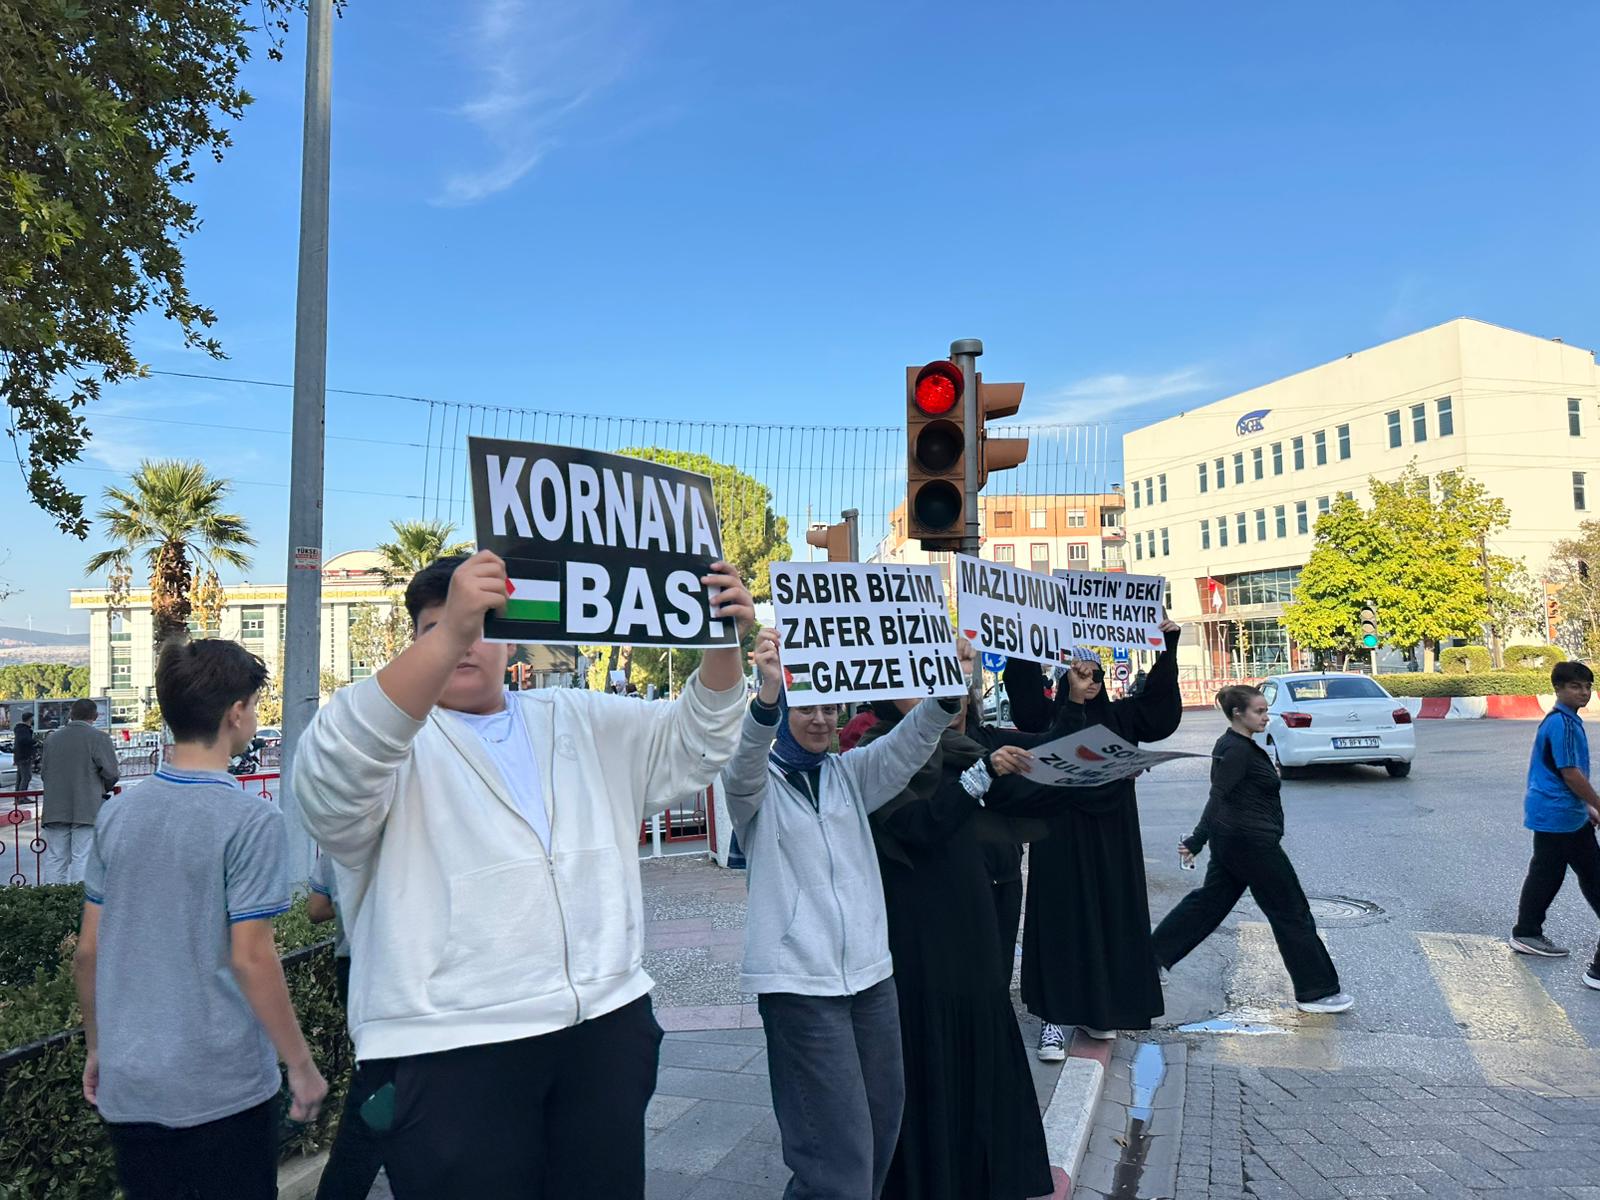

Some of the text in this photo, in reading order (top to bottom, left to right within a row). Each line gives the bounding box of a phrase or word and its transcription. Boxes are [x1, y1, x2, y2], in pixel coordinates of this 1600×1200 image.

[486, 454, 719, 558] KORNAYA
[565, 560, 725, 640] BAS!
[775, 566, 944, 610] SABIR BİZİM,
[960, 560, 1069, 617] MAZLUMUN
[1125, 579, 1161, 602] DEKİ
[781, 607, 953, 649] ZAFER BİZİM
[1069, 600, 1157, 624] ULME HAYIR
[1072, 618, 1147, 645] DİYORSAN
[980, 612, 1060, 661] SESİ OL!
[1116, 646, 1126, 657] H
[811, 649, 964, 695] GAZZE İÇİN
